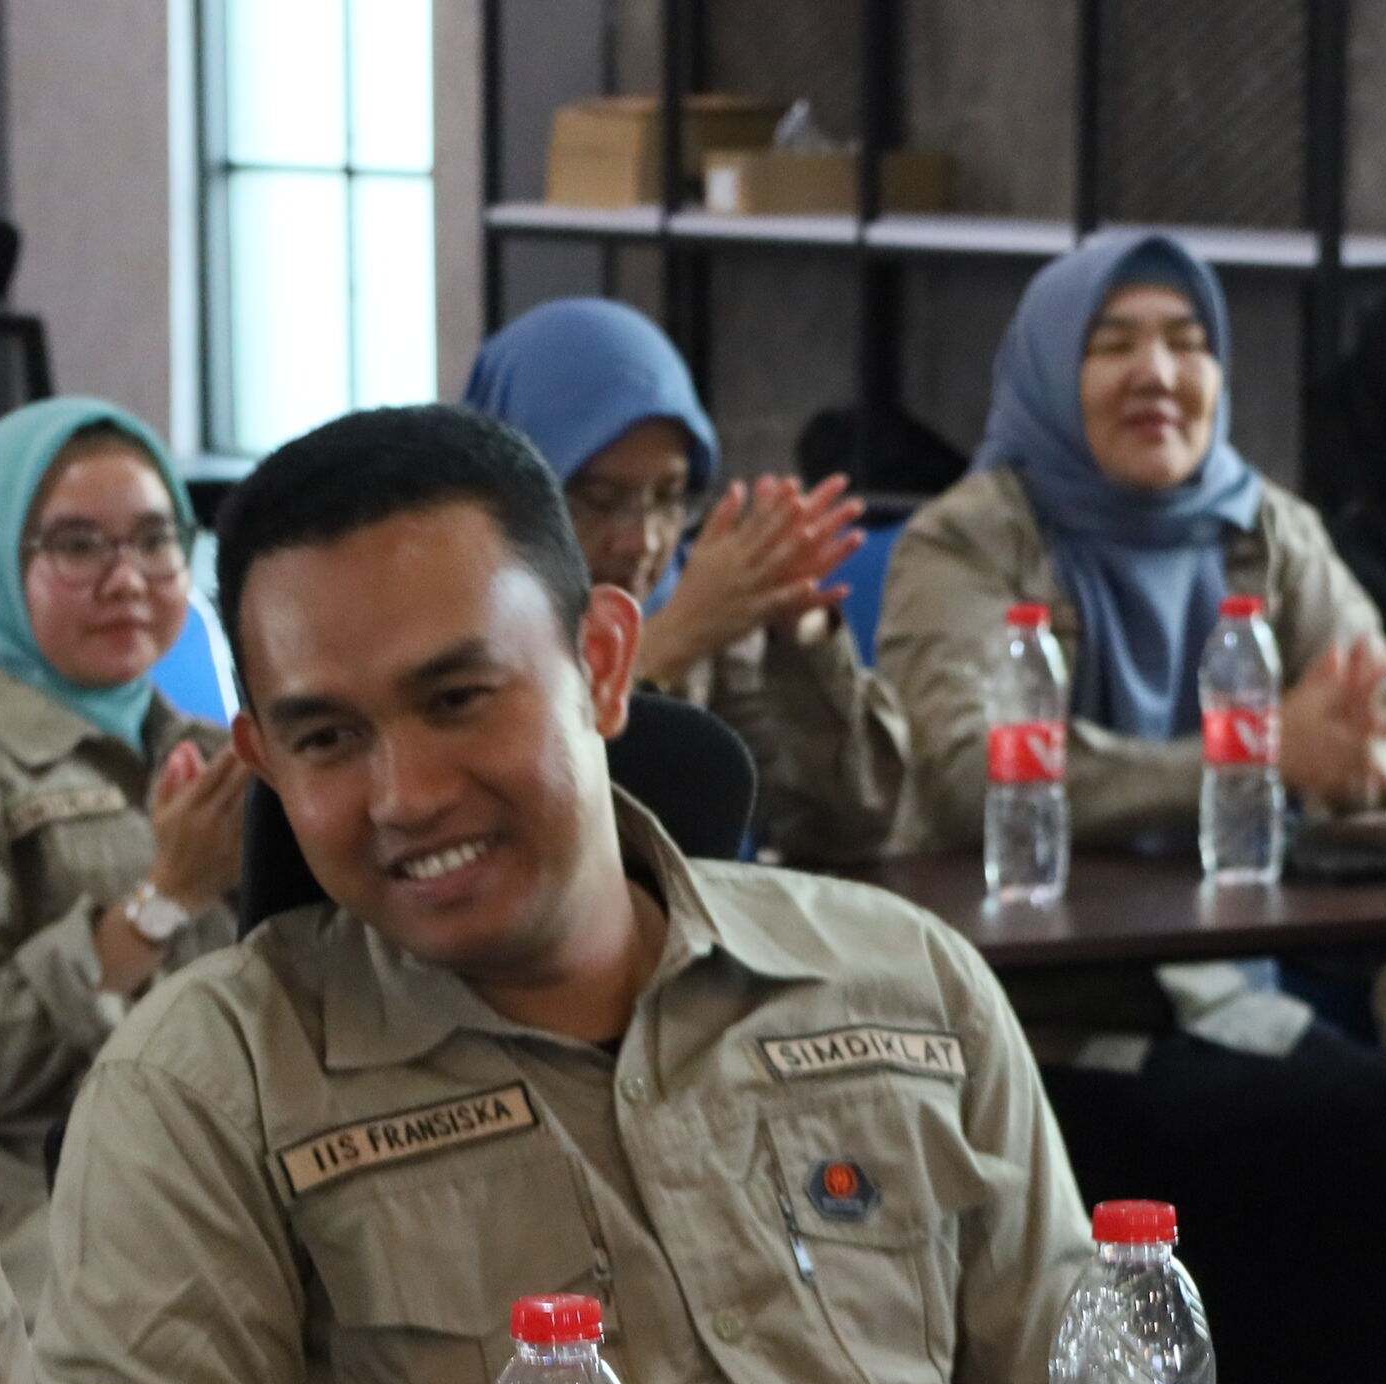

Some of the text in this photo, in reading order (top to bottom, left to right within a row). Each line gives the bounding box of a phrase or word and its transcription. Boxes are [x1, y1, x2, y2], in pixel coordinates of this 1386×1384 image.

[778, 1031, 954, 1068] SIMDIKLAT
[312, 1097, 512, 1172] IIS FRANSISKA
